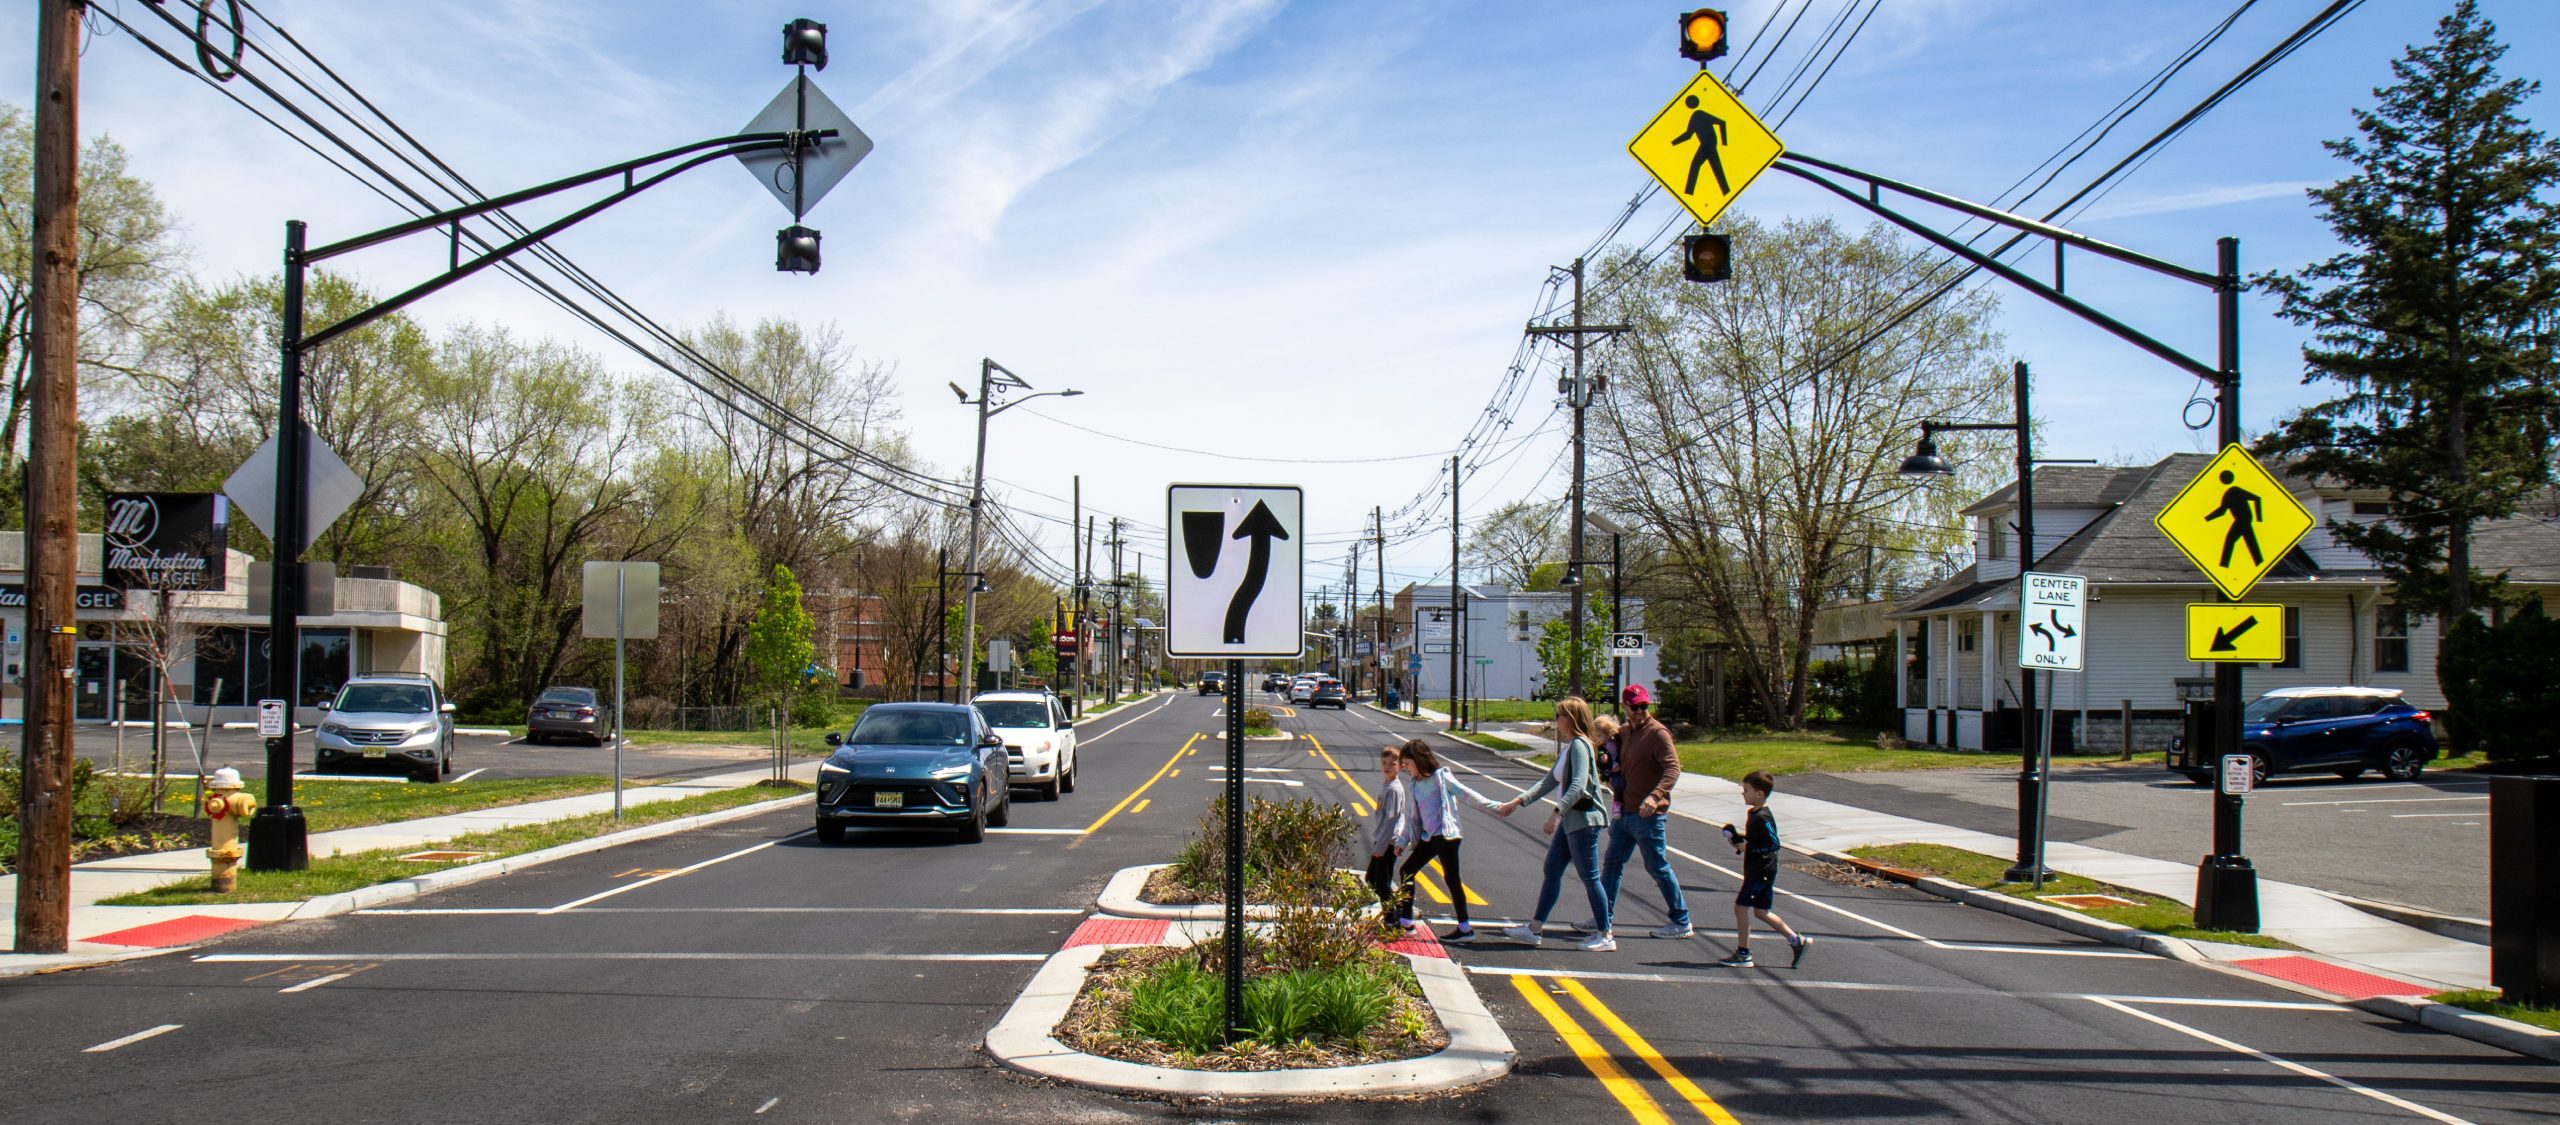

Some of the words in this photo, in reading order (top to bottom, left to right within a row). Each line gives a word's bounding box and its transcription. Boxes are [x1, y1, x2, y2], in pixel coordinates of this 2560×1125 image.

[111, 499, 149, 534] M
[109, 548, 207, 570] Manhattan
[151, 572, 198, 585] BAGEL
[2032, 578, 2078, 590] CENTER
[77, 593, 115, 607] GEL
[2038, 591, 2071, 601] LANE
[2035, 653, 2067, 665] ONLY
